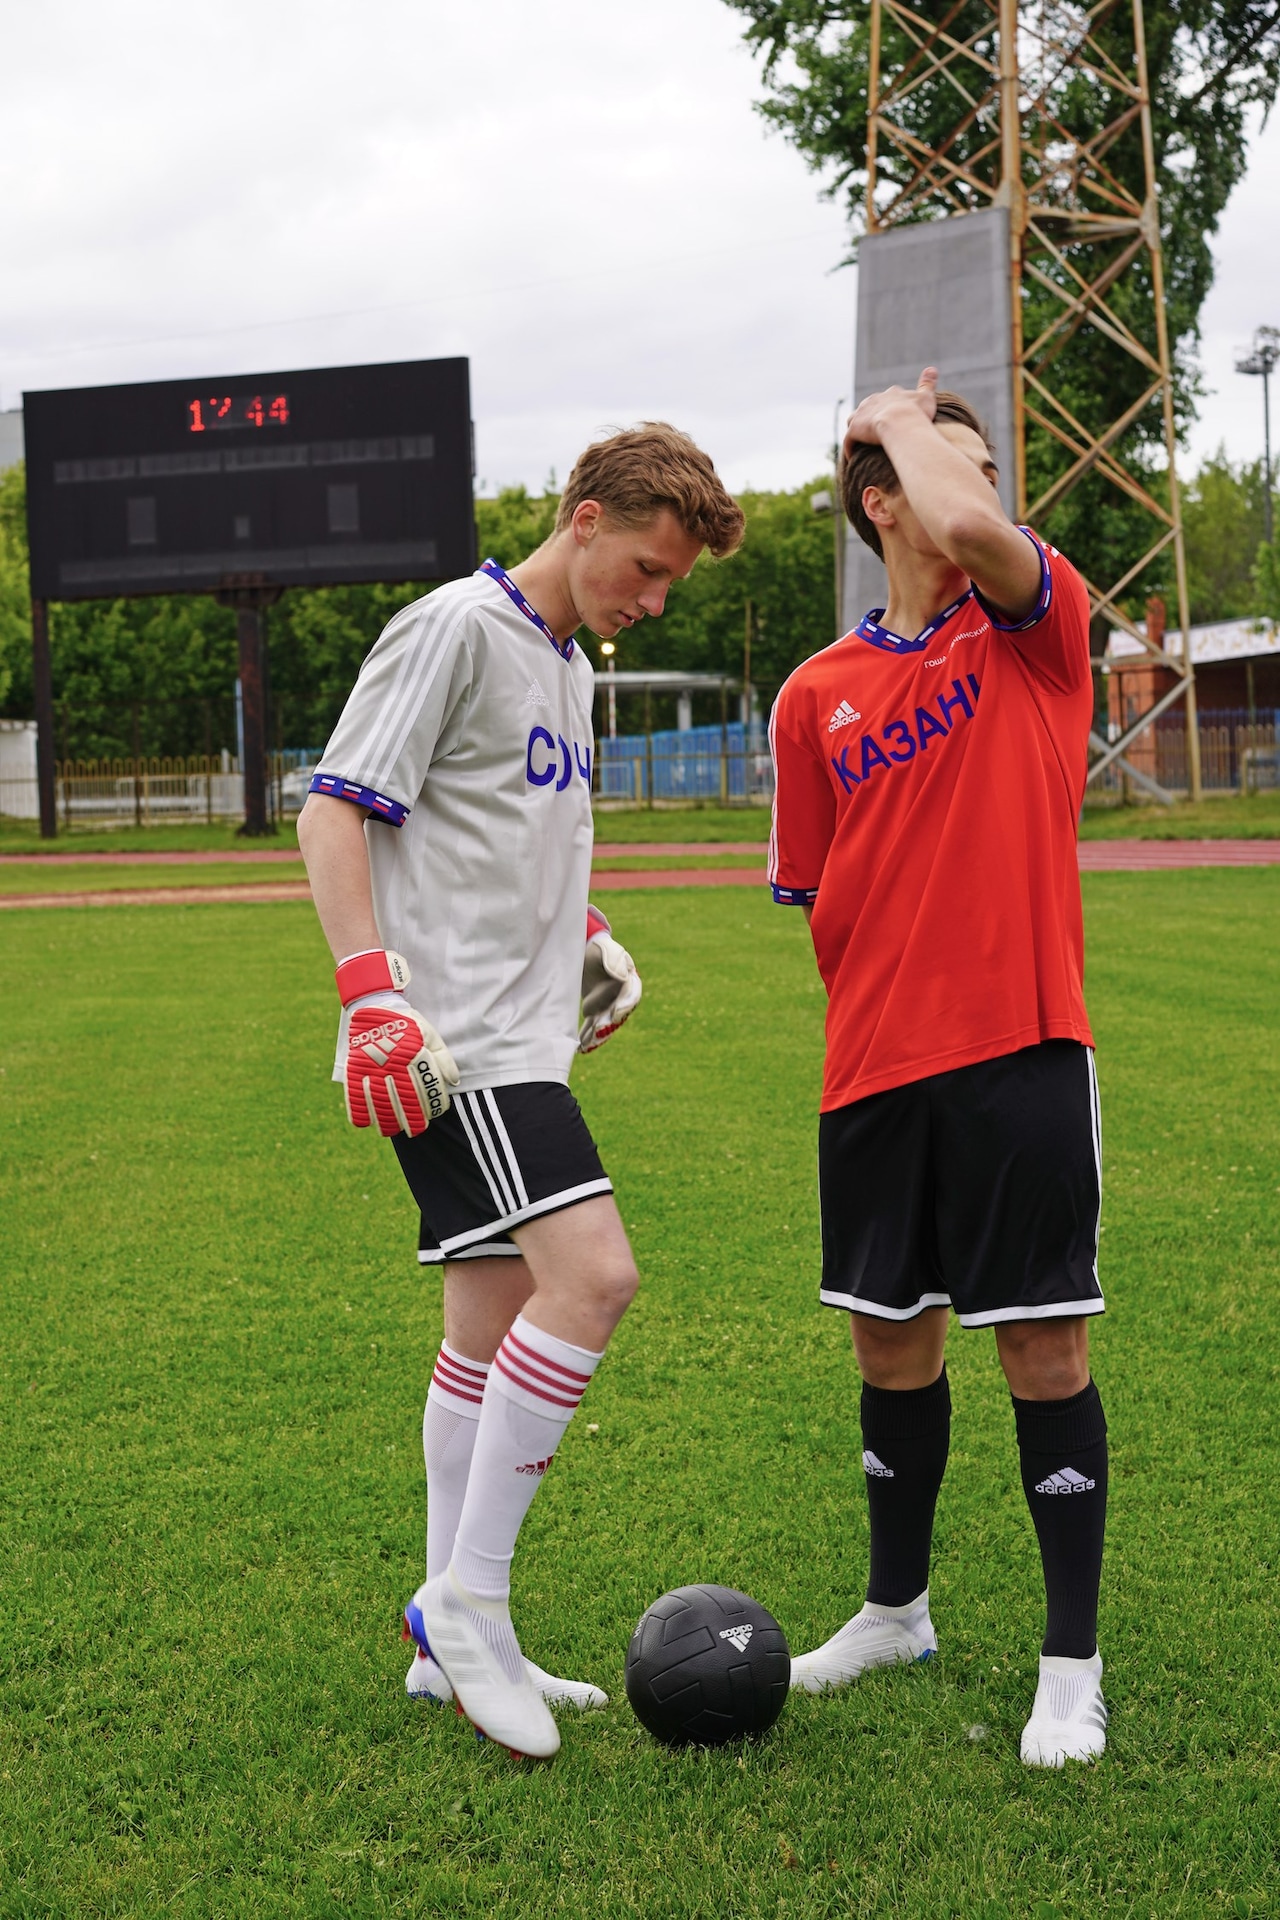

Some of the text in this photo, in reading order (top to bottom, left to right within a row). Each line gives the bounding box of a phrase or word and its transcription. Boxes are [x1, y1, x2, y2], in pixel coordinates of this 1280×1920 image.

[828, 711, 862, 733] adidas
[351, 1019, 409, 1048] adidas
[417, 1060, 443, 1119] adidas
[1034, 1479, 1096, 1495] adidas
[718, 1623, 754, 1639] adidas
